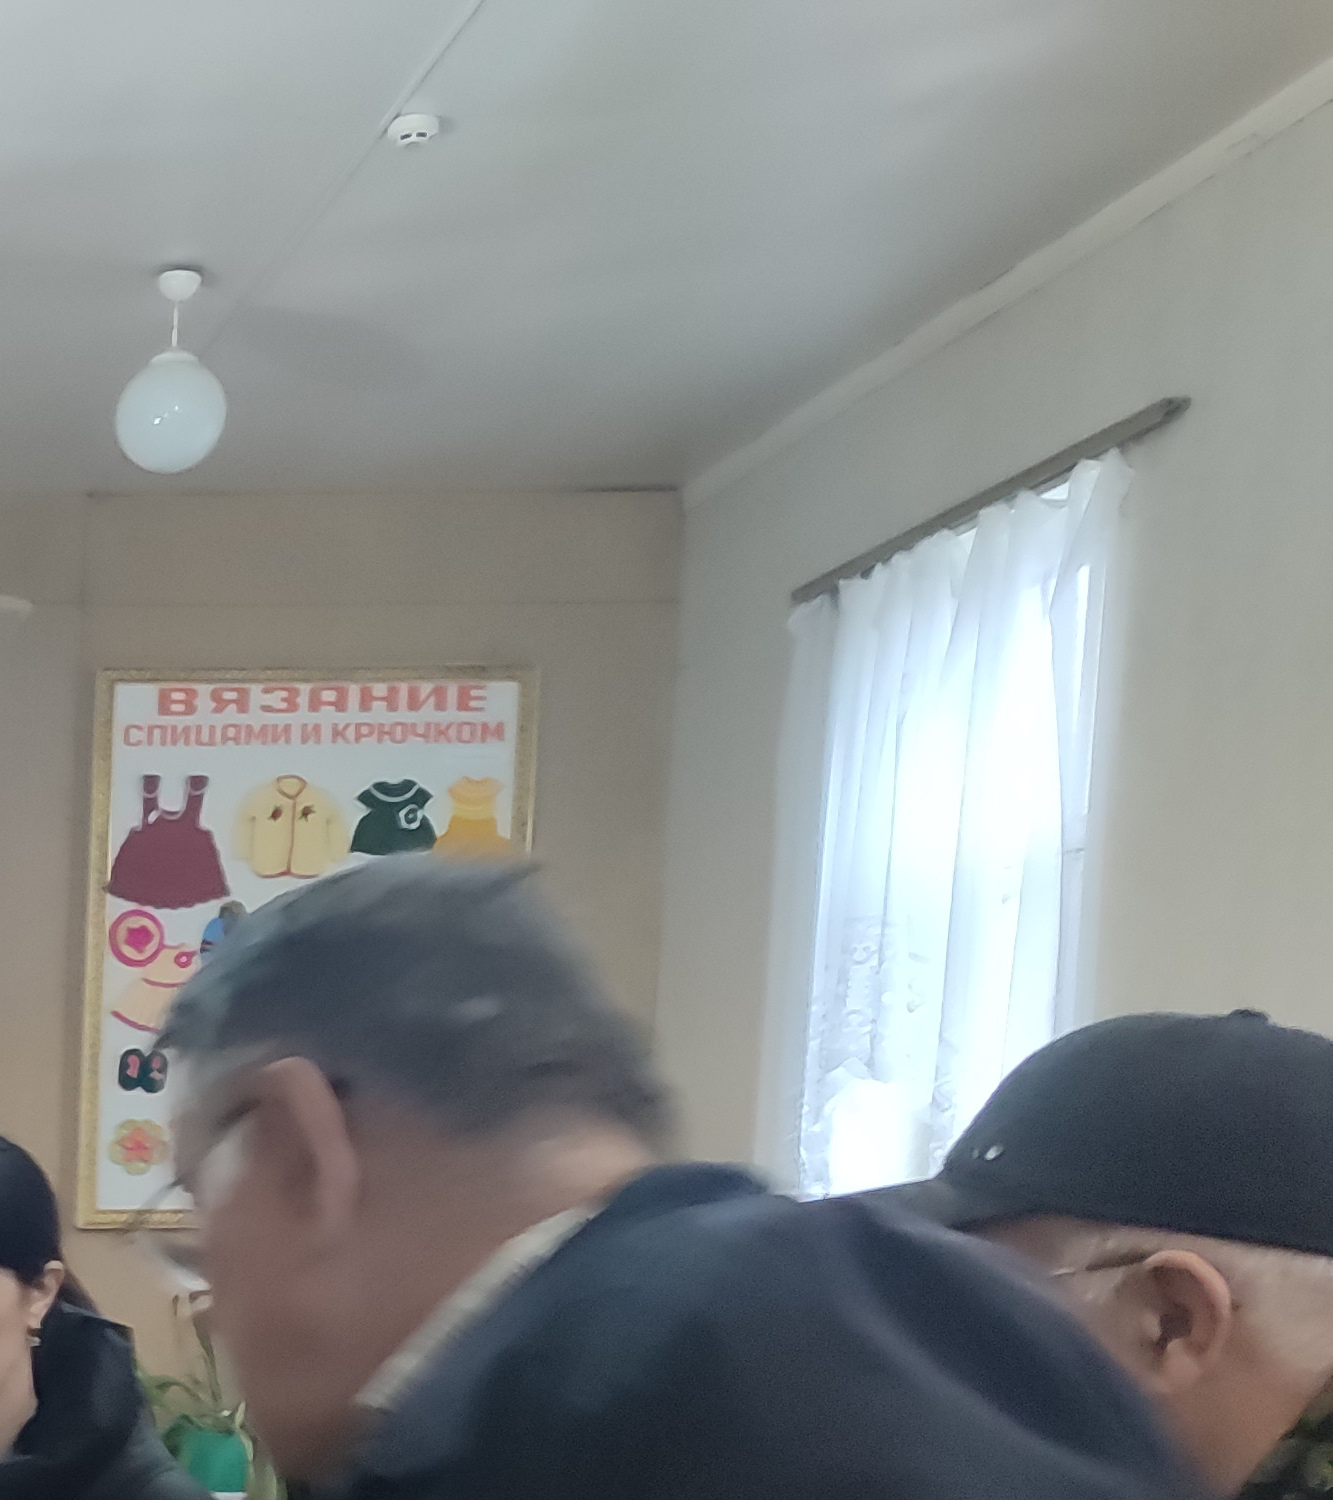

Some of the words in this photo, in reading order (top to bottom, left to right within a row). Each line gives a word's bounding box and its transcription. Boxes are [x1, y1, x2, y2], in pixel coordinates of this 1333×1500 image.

[156, 684, 488, 717] ВЯЗАНИЕ
[122, 723, 292, 748] СПИЦАМИ
[299, 723, 323, 746] И
[331, 720, 506, 746] КРЮЧКОМ
